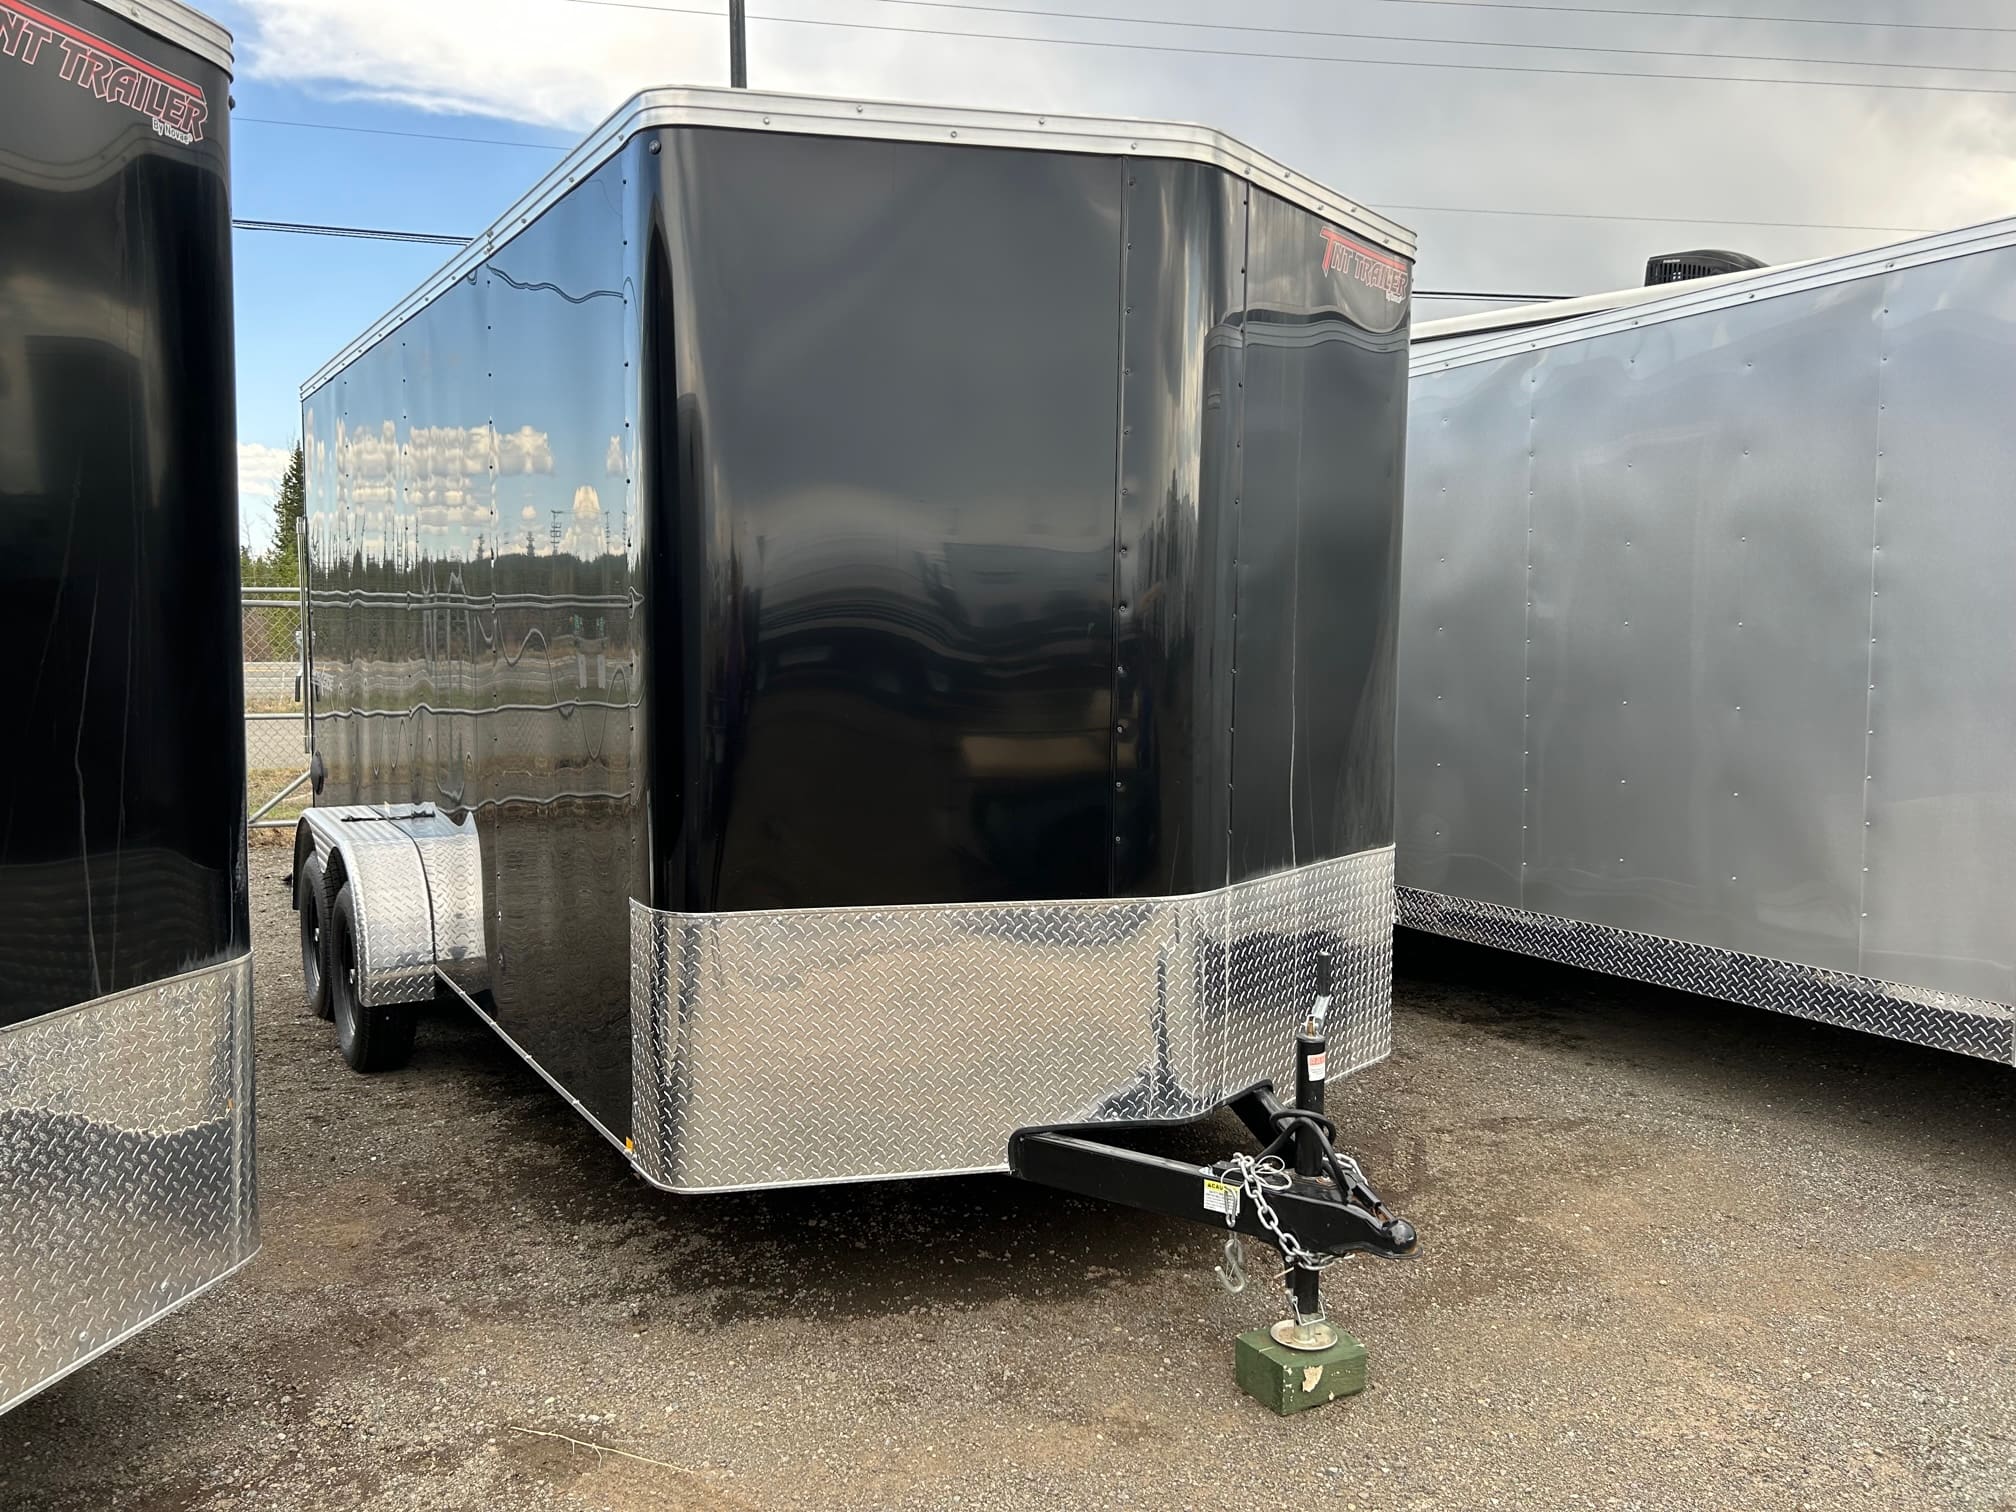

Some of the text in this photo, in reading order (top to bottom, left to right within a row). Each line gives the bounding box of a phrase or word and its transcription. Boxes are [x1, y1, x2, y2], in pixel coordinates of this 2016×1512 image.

[0, 7, 208, 141] NT TRAILER
[1320, 226, 1408, 300] TNT TRAILER
